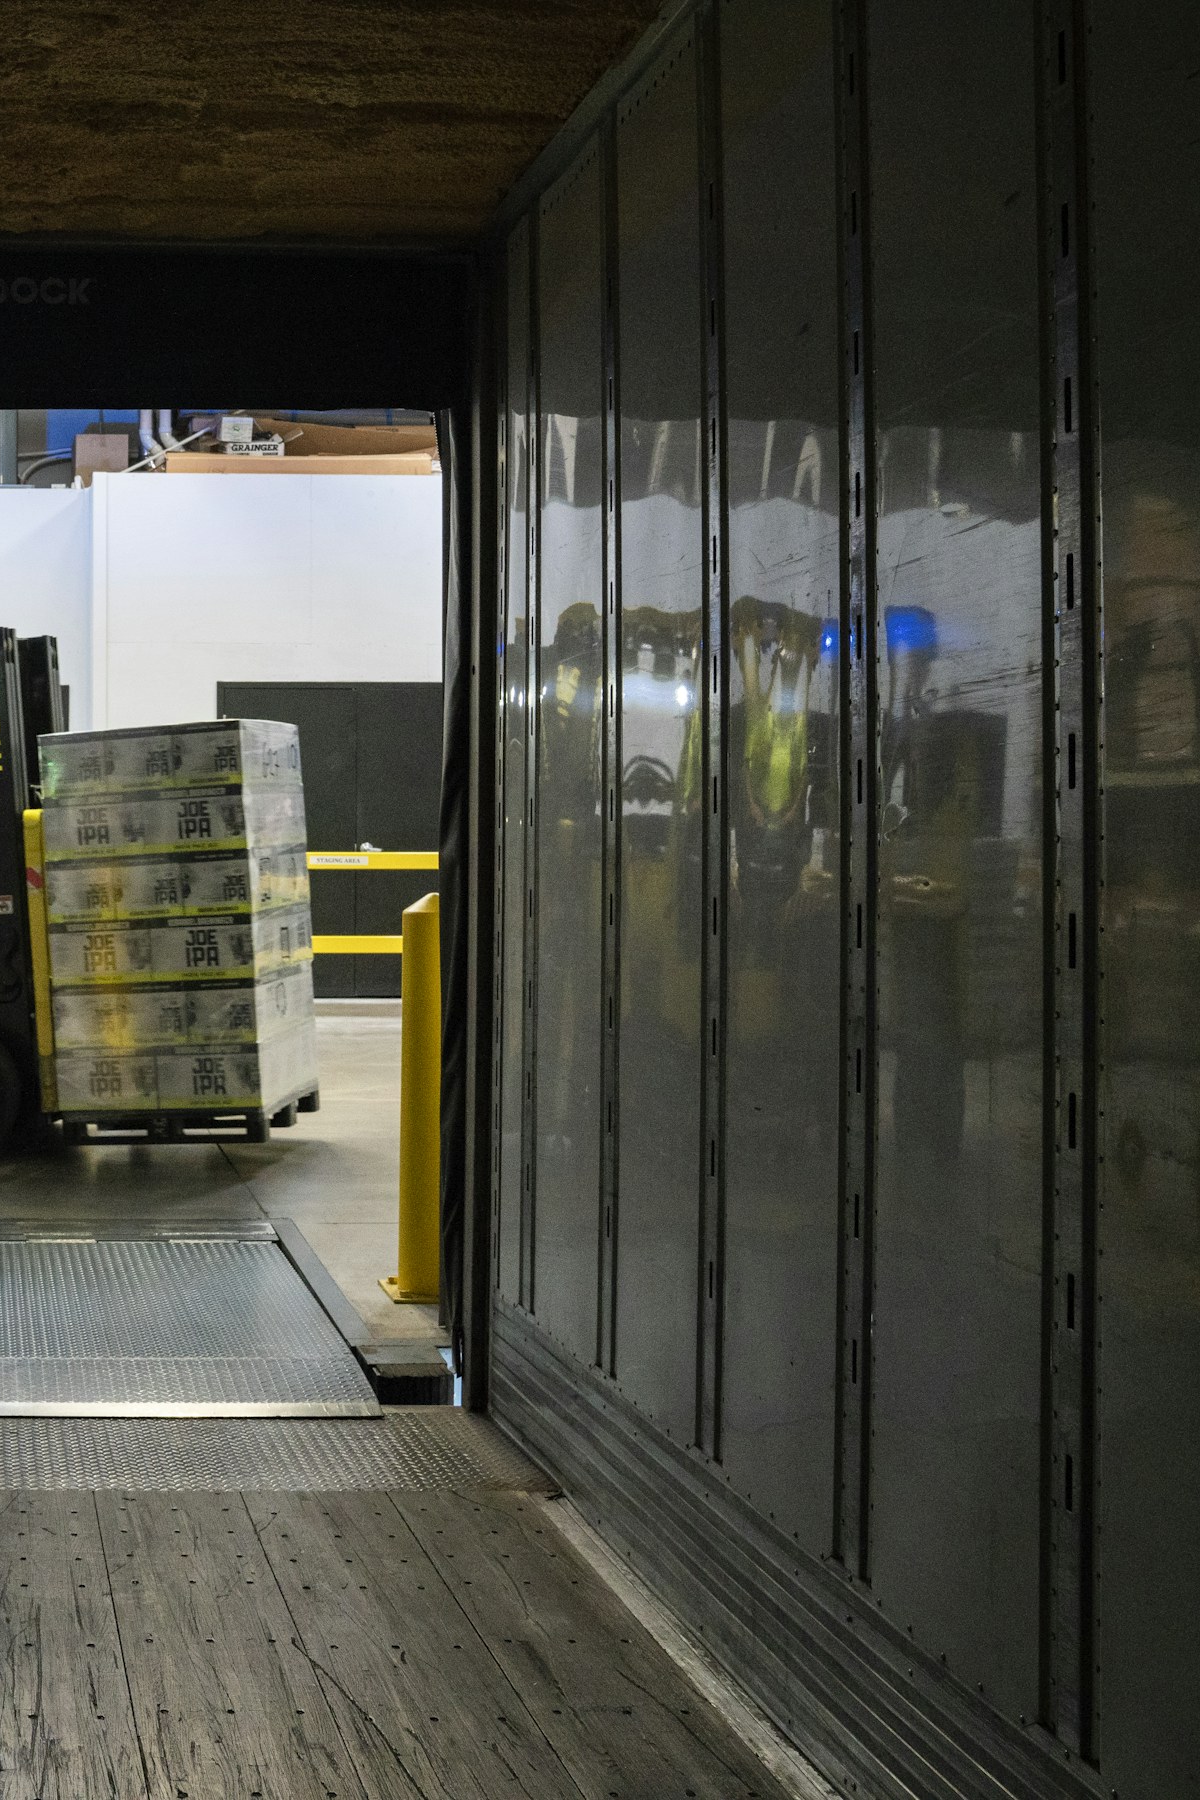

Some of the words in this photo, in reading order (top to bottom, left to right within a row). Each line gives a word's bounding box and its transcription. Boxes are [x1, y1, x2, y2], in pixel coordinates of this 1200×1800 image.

[231, 443, 279, 453] GRAINGER
[215, 746, 236, 757] JOE
[215, 758, 237, 771] IPA
[77, 808, 107, 824] JOE
[177, 801, 208, 817] JOE
[78, 826, 110, 845] IPA
[178, 818, 212, 839] IPA
[154, 879, 176, 890] JOE
[224, 875, 245, 886] JOE
[155, 890, 178, 904] IPA
[223, 887, 247, 901] IPA
[83, 934, 115, 950] JOE
[185, 929, 217, 945] JOE
[84, 951, 117, 971] IPA
[186, 946, 220, 967] IPA
[89, 1061, 120, 1075] JOE
[192, 1058, 225, 1074] JOE
[90, 1077, 122, 1097] IPA
[193, 1075, 226, 1095] IPA
